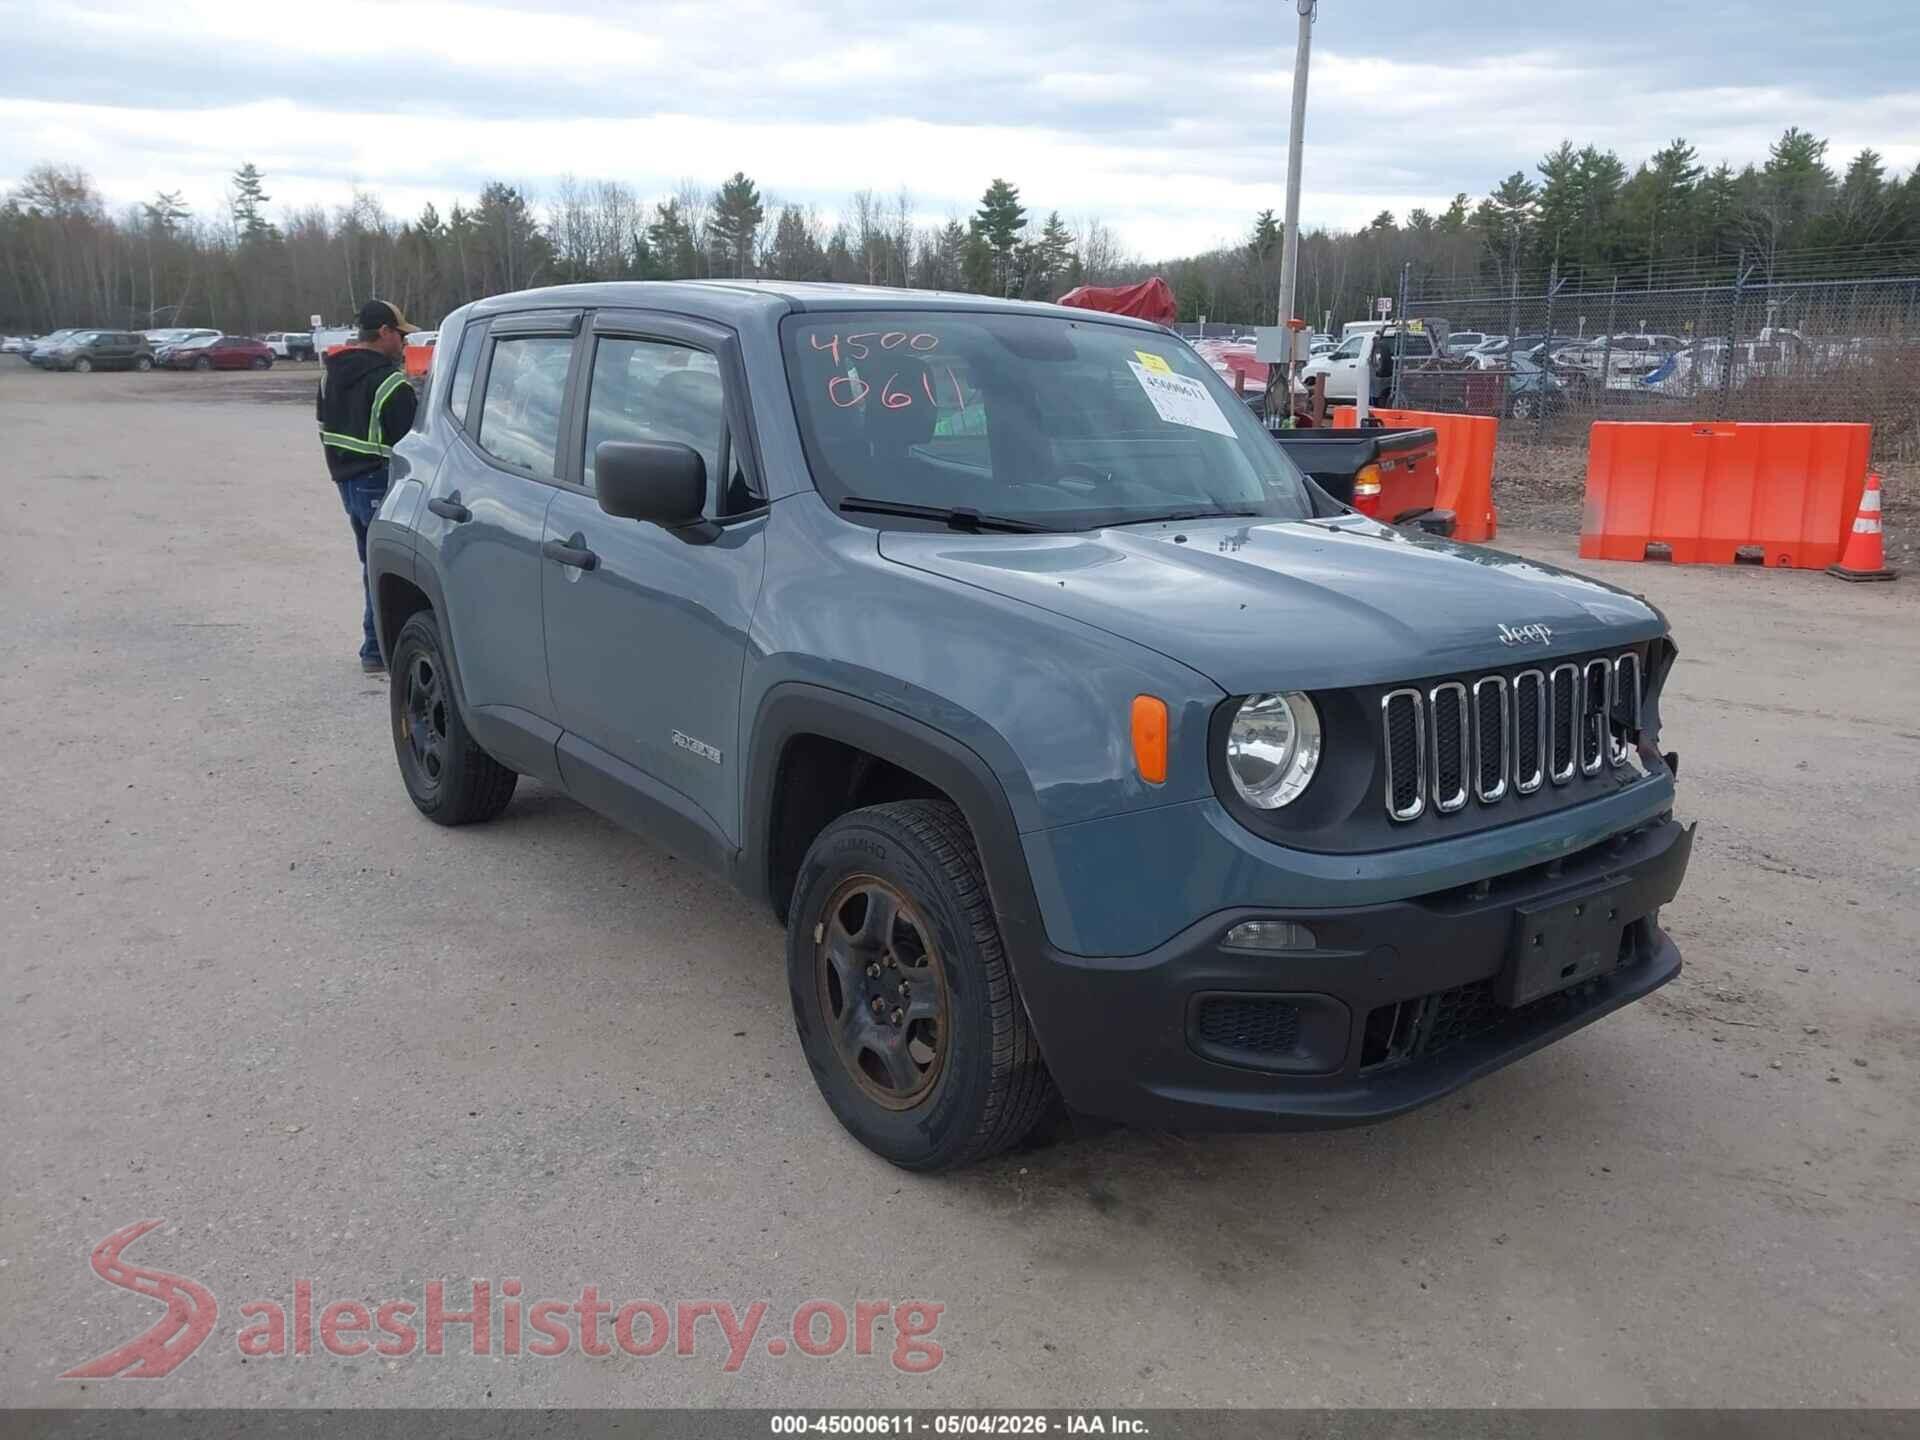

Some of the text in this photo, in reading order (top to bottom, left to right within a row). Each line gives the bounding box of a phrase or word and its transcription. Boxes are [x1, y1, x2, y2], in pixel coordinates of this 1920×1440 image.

[811, 331, 938, 367] 4500
[828, 367, 966, 411] 0611
[1497, 622, 1552, 647] Jeep
